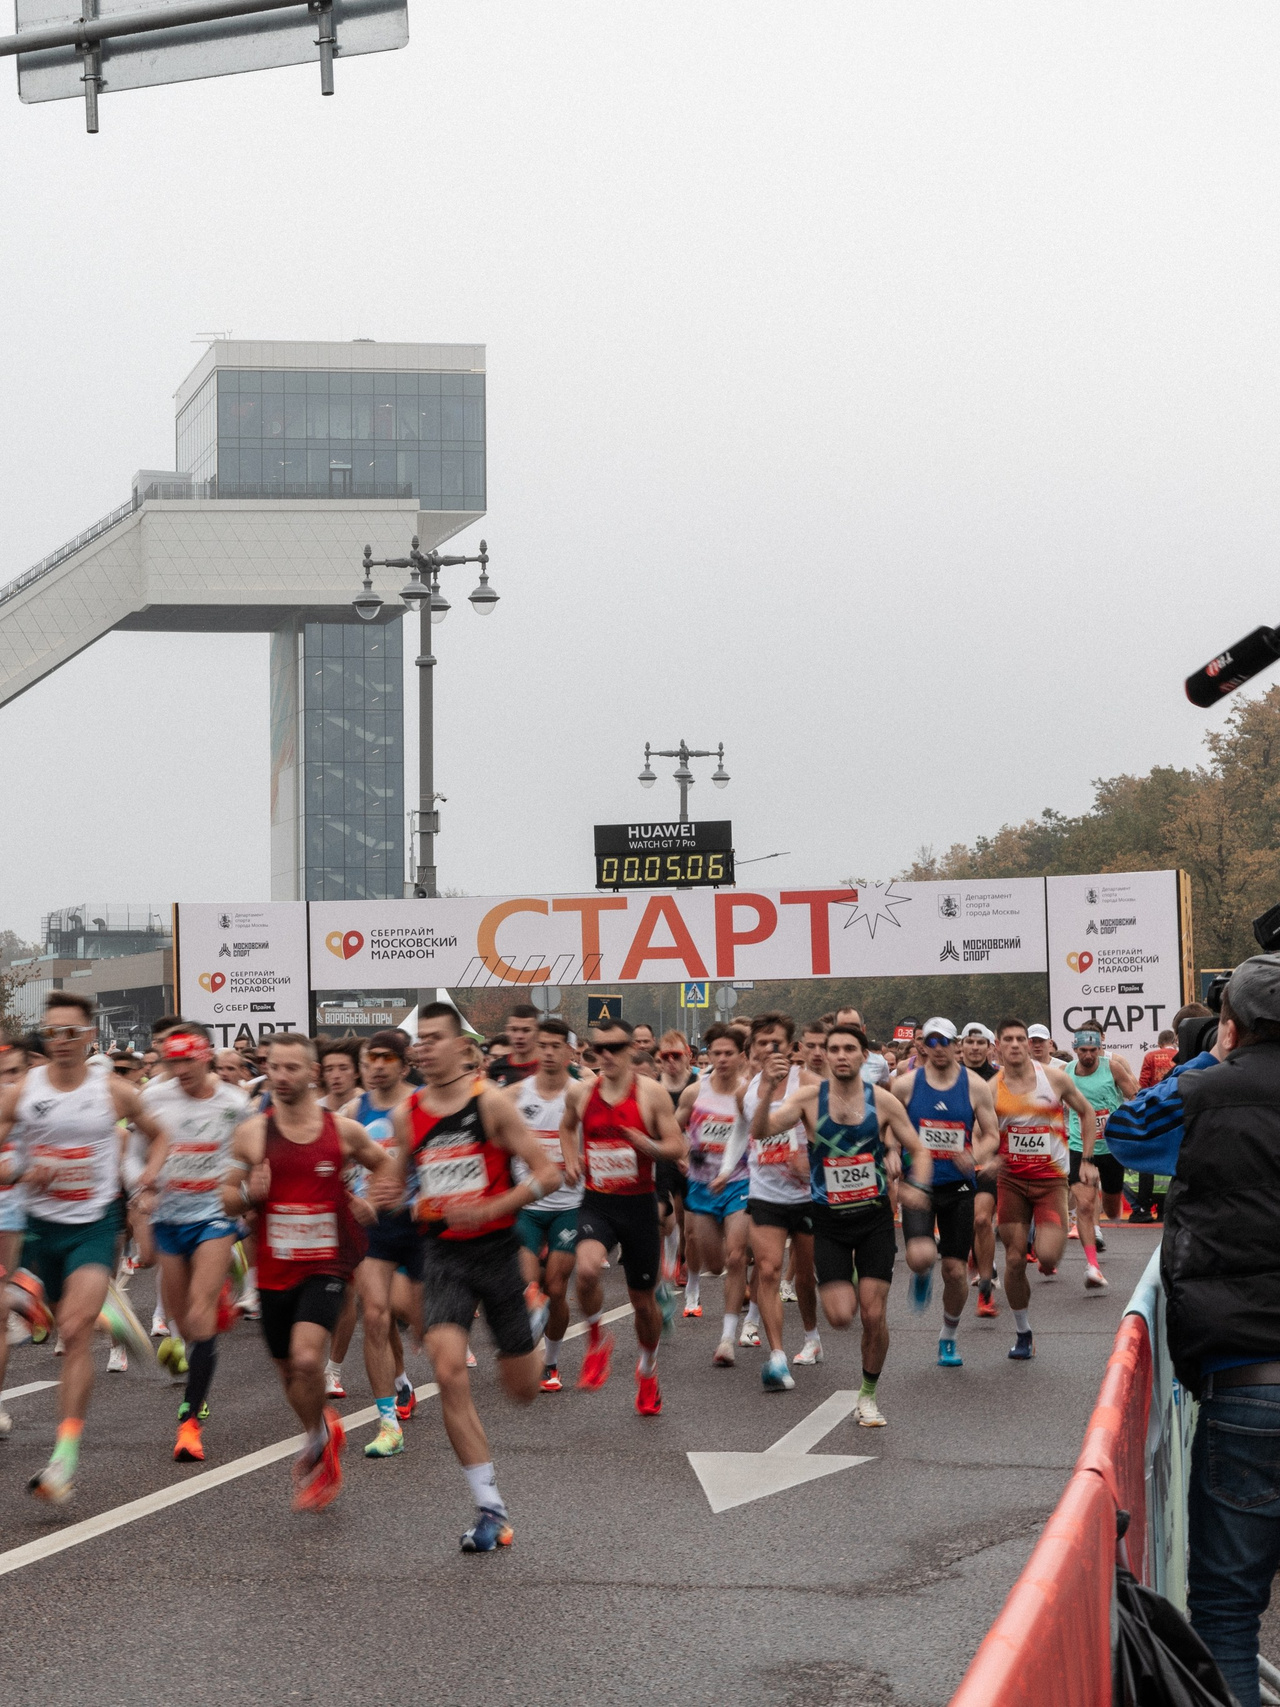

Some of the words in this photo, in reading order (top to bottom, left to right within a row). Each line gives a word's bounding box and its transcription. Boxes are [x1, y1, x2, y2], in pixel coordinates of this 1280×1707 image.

[628, 823, 696, 839] HUAWEI
[628, 840, 660, 849] WATCH
[661, 839, 673, 848] GT
[675, 839, 681, 848] 7
[682, 839, 696, 847] Pro
[965, 893, 1012, 901] Департамент
[1100, 916, 1136, 926] МОСКОВСКИЙ
[370, 927, 434, 937] СБЕРПРАЙМ
[1100, 926, 1117, 934] СПОРТ
[370, 935, 457, 948] МОСКОВСКИЙ
[477, 889, 858, 984] СТАРТ
[232, 940, 269, 950] МОСКОВСКИЙ
[962, 935, 1021, 950] МОСКОВСКИЙ
[232, 949, 250, 957] СПОРТ
[371, 949, 435, 960] МАРАФОН
[963, 950, 990, 961] СПОРТ
[1097, 948, 1143, 956] СБЕРПРАЙМ
[1097, 954, 1159, 965] МОСКОВСКИЙ
[1098, 965, 1143, 973] МАРАФОН
[230, 976, 291, 985] МОСКОВСКИЙ
[230, 985, 275, 993] МАРАФОН
[1093, 985, 1117, 993] СБЕР
[225, 1004, 249, 1012] СБЕР
[325, 1012, 370, 1024] ВОРОБЬЕВЫ
[372, 1012, 392, 1024] ГОРЫ
[1063, 1004, 1166, 1033] СТАРТ
[925, 1130, 959, 1145] 5832
[1013, 1135, 1045, 1148] 7464
[833, 1166, 870, 1184] 1284
